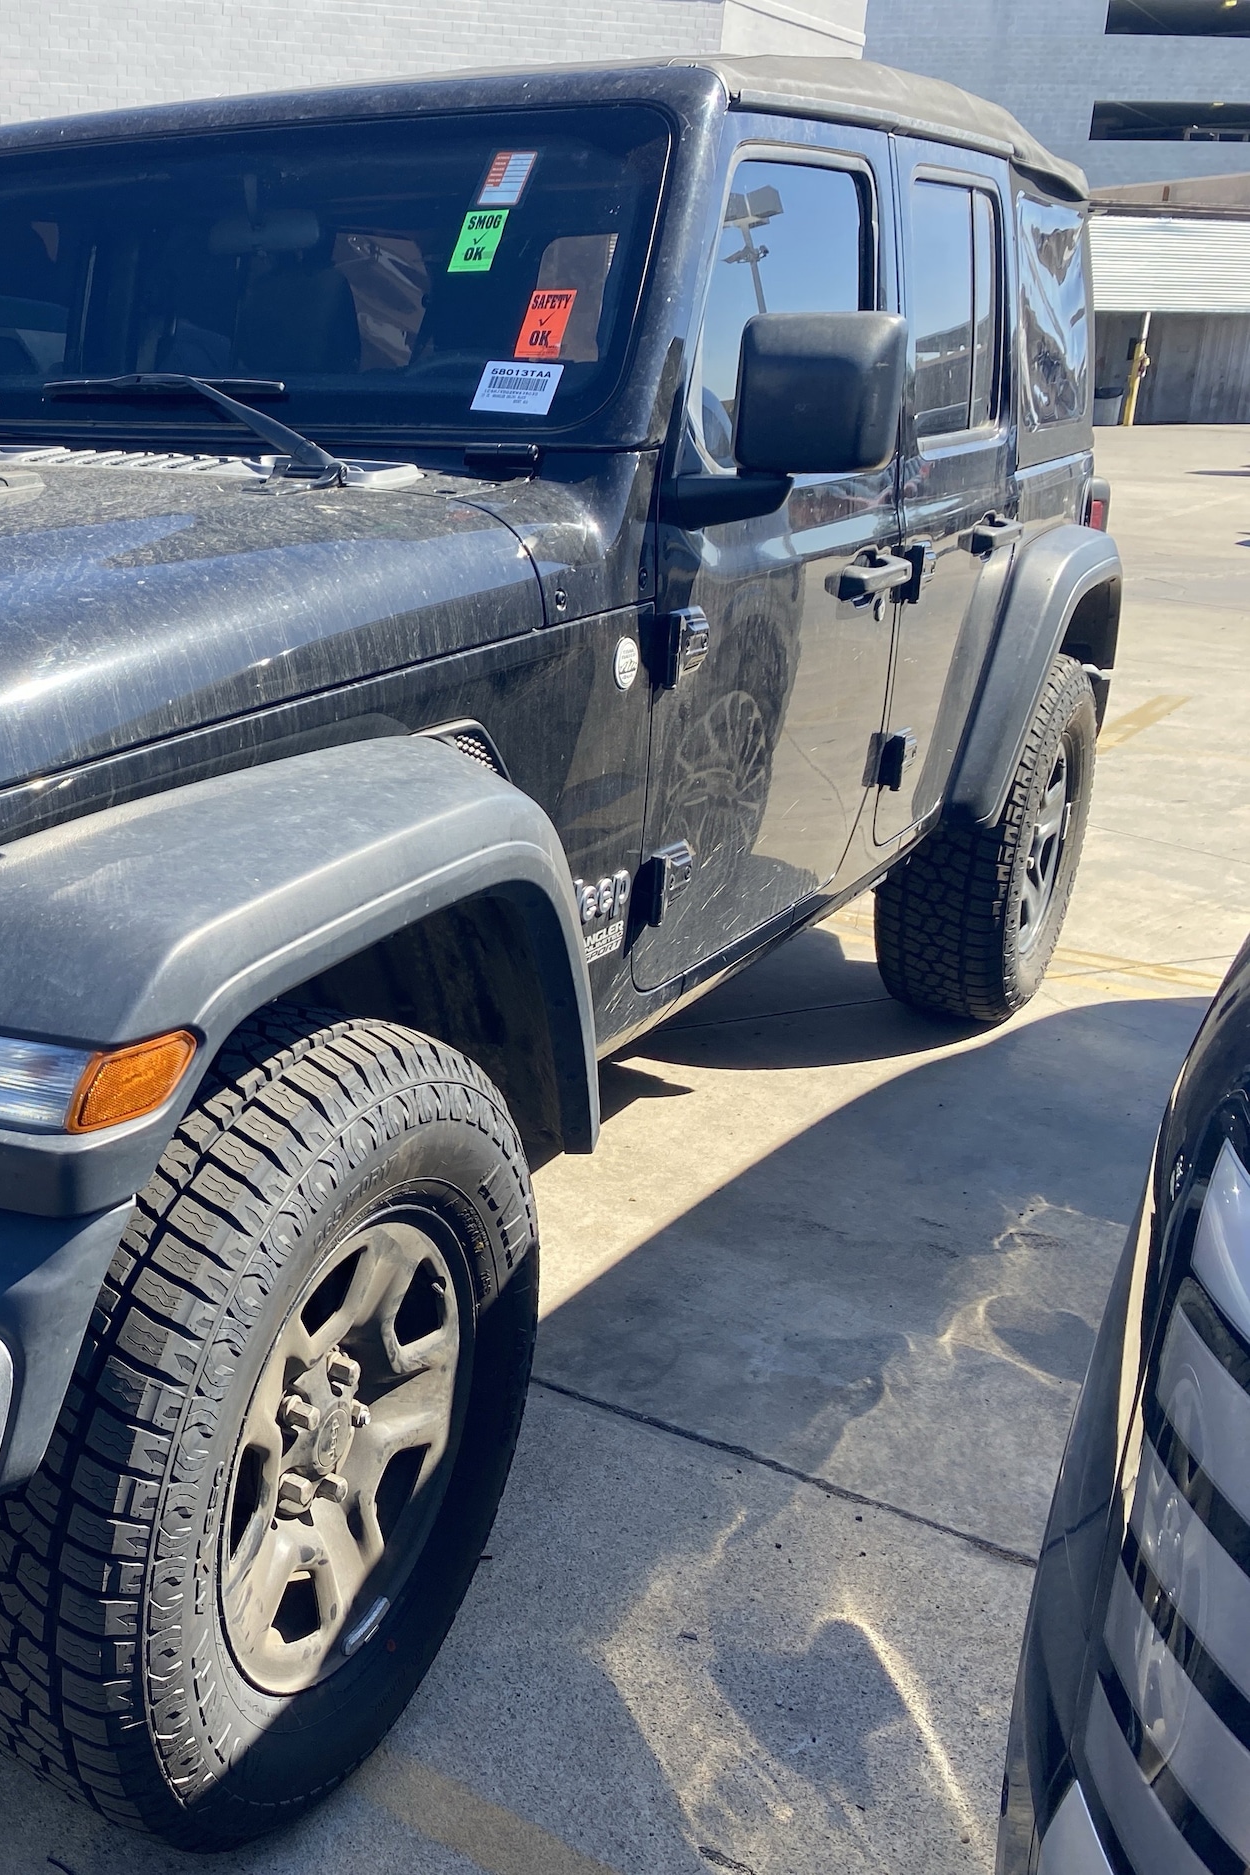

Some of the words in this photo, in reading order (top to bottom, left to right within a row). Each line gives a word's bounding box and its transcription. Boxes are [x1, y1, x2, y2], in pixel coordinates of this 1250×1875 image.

[467, 214, 502, 230] SMOG
[463, 246, 485, 261] OK
[531, 294, 571, 309] SAFETY
[529, 330, 551, 348] OK
[583, 920, 625, 948] NGLER
[584, 930, 624, 954] NLIMITED
